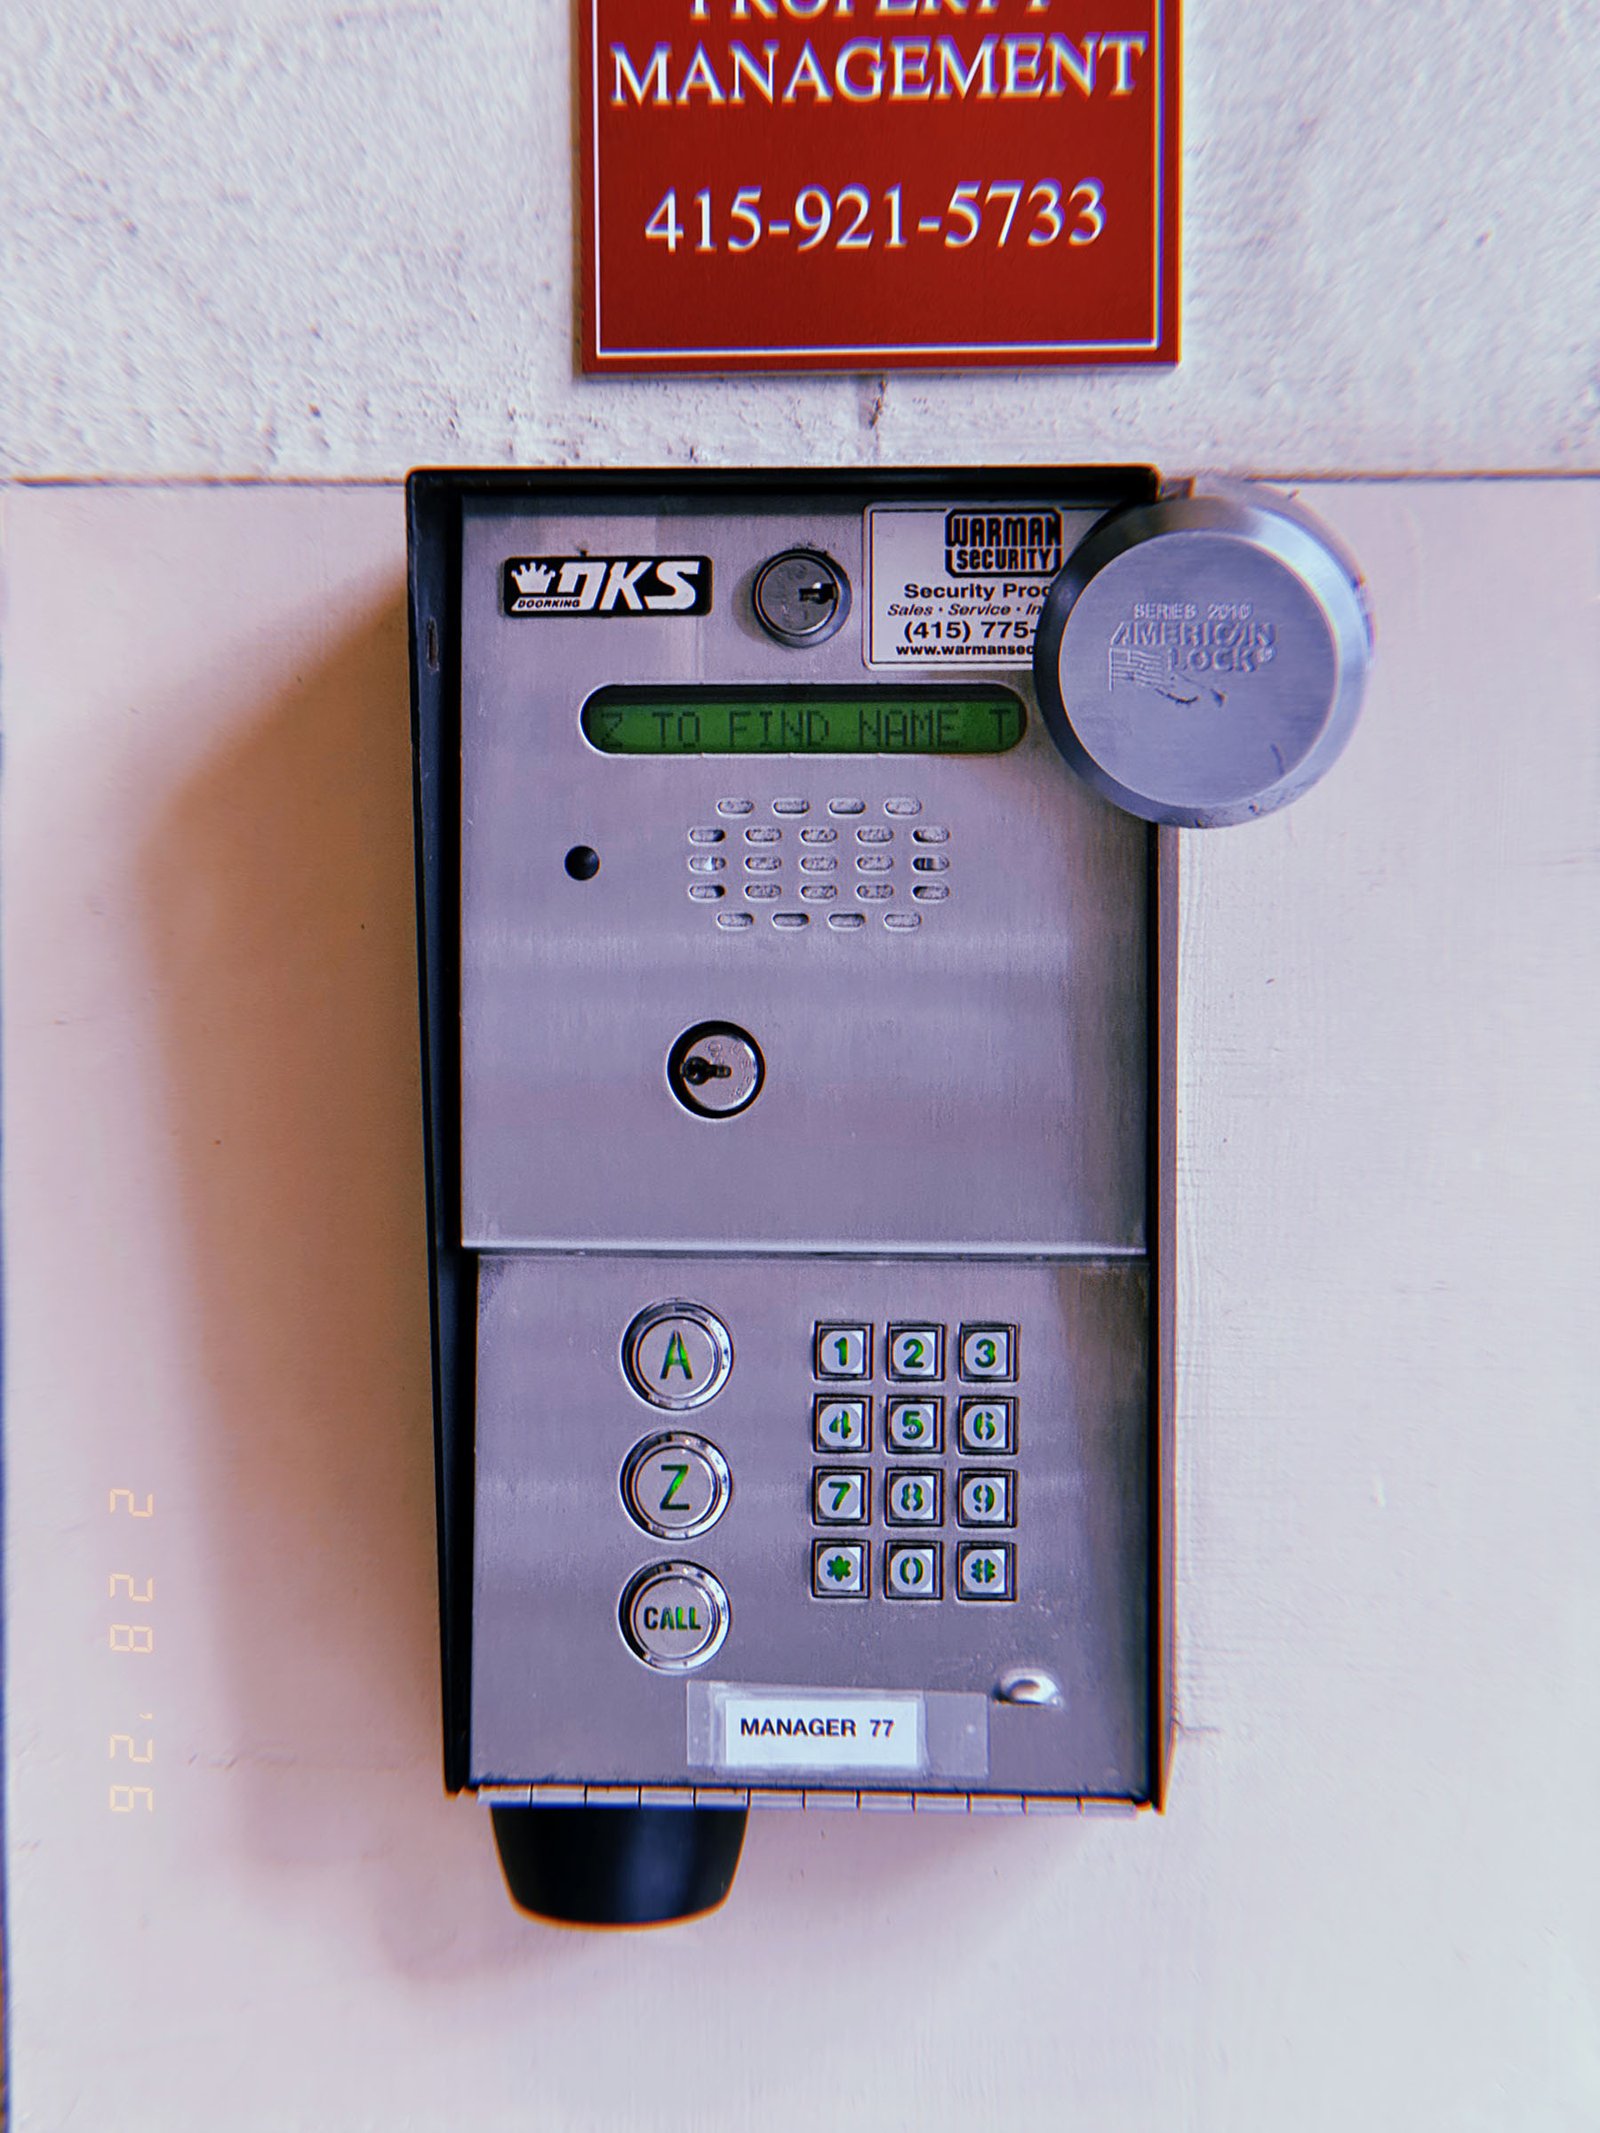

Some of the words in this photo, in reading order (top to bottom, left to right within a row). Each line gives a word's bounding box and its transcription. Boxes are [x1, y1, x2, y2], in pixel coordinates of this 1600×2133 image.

[611, 32, 1148, 106] MANAGEMENT
[645, 177, 1107, 252] 415-921-5733
[951, 516, 1061, 547] WARMAN
[556, 561, 700, 610] DKS
[904, 583, 995, 601] Security
[517, 598, 580, 609] DOORKING
[887, 603, 934, 617] Sales
[948, 603, 1012, 617] Service
[1133, 602, 1197, 620] SERIES
[903, 620, 972, 643] (415)
[1110, 620, 1277, 647] AMERICAN
[652, 711, 700, 748] TO
[728, 710, 830, 748] FIND
[858, 709, 961, 747] NAME
[659, 1330, 693, 1380] A
[833, 1337, 848, 1367] 1
[902, 1338, 924, 1368] 2
[975, 1338, 996, 1369] 3
[829, 1410, 852, 1439] 4
[902, 1410, 923, 1440] 5
[973, 1411, 995, 1441] 6
[659, 1464, 690, 1511] Z
[828, 1482, 850, 1511] 7
[901, 1482, 923, 1512] 8
[972, 1483, 995, 1513] 9
[899, 1557, 923, 1585] 0
[643, 1606, 702, 1631] CALL
[739, 1718, 857, 1737] MANAGER
[869, 1719, 895, 1737] 77
